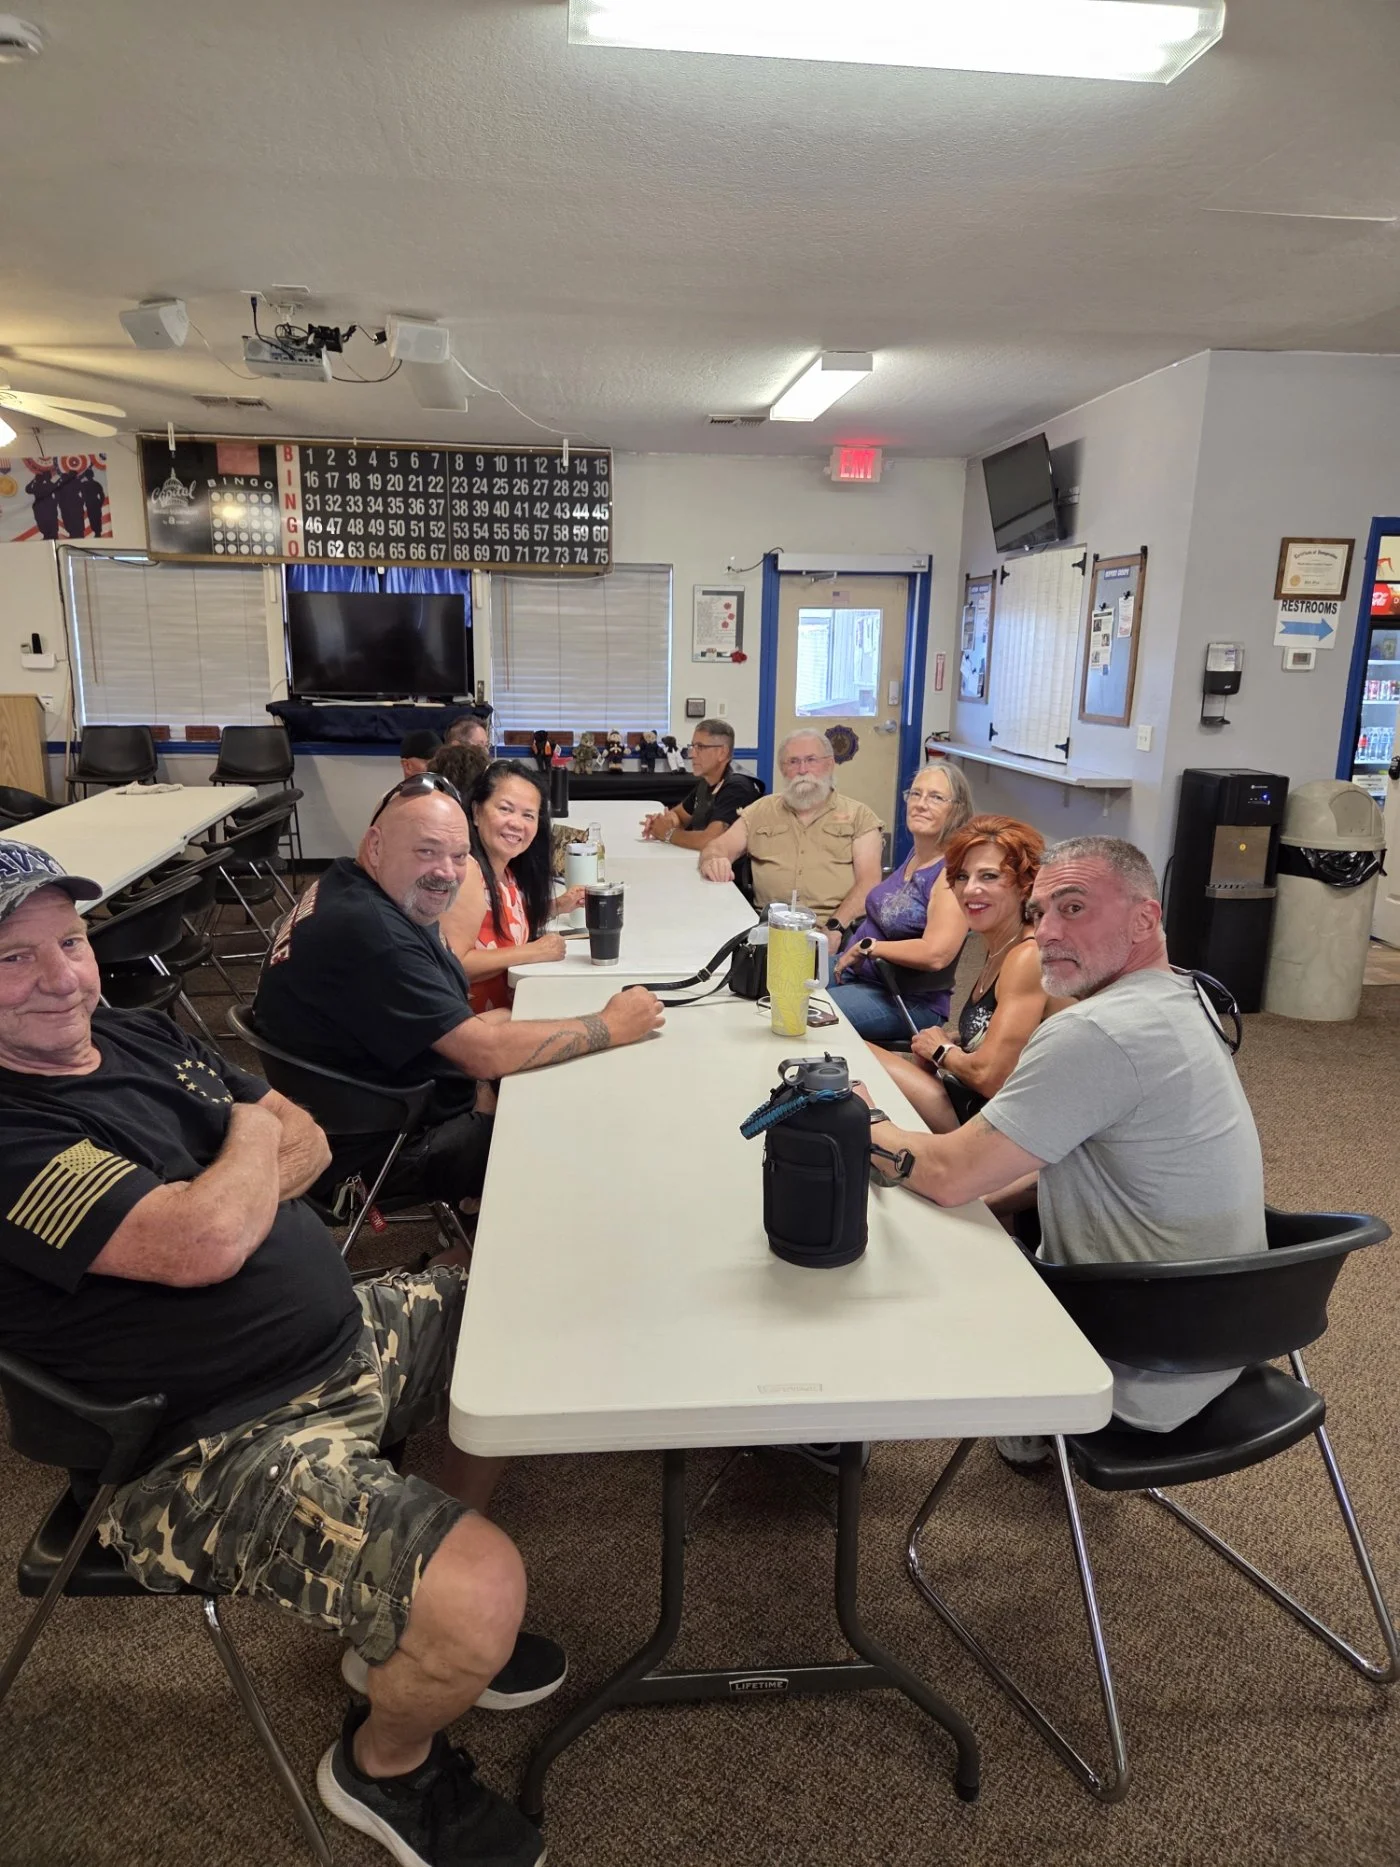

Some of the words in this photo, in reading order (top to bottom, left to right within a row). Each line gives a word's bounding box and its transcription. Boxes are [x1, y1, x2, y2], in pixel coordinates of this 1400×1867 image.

[306, 448, 313, 465] 1
[328, 449, 335, 465] 2
[348, 450, 356, 466] 3
[369, 451, 377, 467] 4
[390, 452, 398, 468] 5
[411, 452, 418, 468] 6
[432, 453, 439, 469] 7
[455, 454, 463, 471] 8
[476, 455, 484, 471] 9
[494, 456, 507, 472] 10
[515, 456, 527, 472] 11
[534, 457, 548, 473] 12
[574, 459, 587, 474] 14
[594, 459, 607, 475] 15
[840, 450, 875, 478] EXIT
[207, 477, 274, 489] BINGO
[304, 471, 319, 488] 16
[325, 472, 339, 488] 17
[346, 473, 360, 489] 18
[367, 474, 381, 490] 19
[387, 475, 403, 491] 20
[409, 475, 422, 492] 21
[428, 476, 444, 492] 22
[452, 477, 467, 493] 23
[473, 478, 488, 494] 24
[493, 479, 508, 494] 25
[513, 479, 529, 495] 26
[533, 480, 548, 496] 27
[553, 480, 569, 496] 28
[573, 481, 588, 497] 29
[593, 481, 608, 498] 30
[305, 494, 320, 511] 31
[326, 495, 342, 512] 32
[346, 496, 363, 513] 33
[367, 497, 383, 513] 34
[388, 498, 404, 514] 35
[409, 499, 424, 515] 36
[429, 500, 444, 516] 37
[452, 500, 468, 516] 38
[473, 501, 489, 517] 39
[493, 501, 509, 517] 40
[514, 502, 529, 518] 41
[533, 502, 549, 518] 42
[554, 503, 570, 519] 43
[572, 503, 589, 519] 44
[592, 504, 608, 520] 45
[305, 517, 322, 533] 46
[327, 518, 342, 534] 47
[348, 519, 364, 535] 48
[368, 520, 384, 536] 49
[389, 520, 405, 536] 50
[411, 521, 424, 537] 51
[430, 522, 445, 538] 52
[453, 523, 469, 539] 53
[473, 523, 489, 539] 54
[493, 524, 509, 540] 55
[514, 525, 529, 540] 56
[534, 525, 549, 541] 57
[553, 525, 569, 541] 58
[573, 526, 588, 542] 59
[593, 526, 608, 542] 60
[308, 540, 322, 556] 61
[328, 541, 344, 558] 62
[348, 542, 364, 558] 63
[369, 543, 385, 558] 64
[390, 543, 406, 559] 65
[410, 544, 426, 559] 66
[431, 545, 446, 560] 67
[454, 545, 469, 561] 68
[474, 545, 490, 561] 69
[494, 546, 510, 562] 70
[515, 546, 529, 562] 71
[534, 547, 549, 562] 72
[554, 547, 569, 563] 73
[574, 548, 588, 563] 74
[594, 548, 608, 564] 75
[1281, 600, 1338, 615] RESTROOMS
[735, 1682, 784, 1690] LIFETIME
